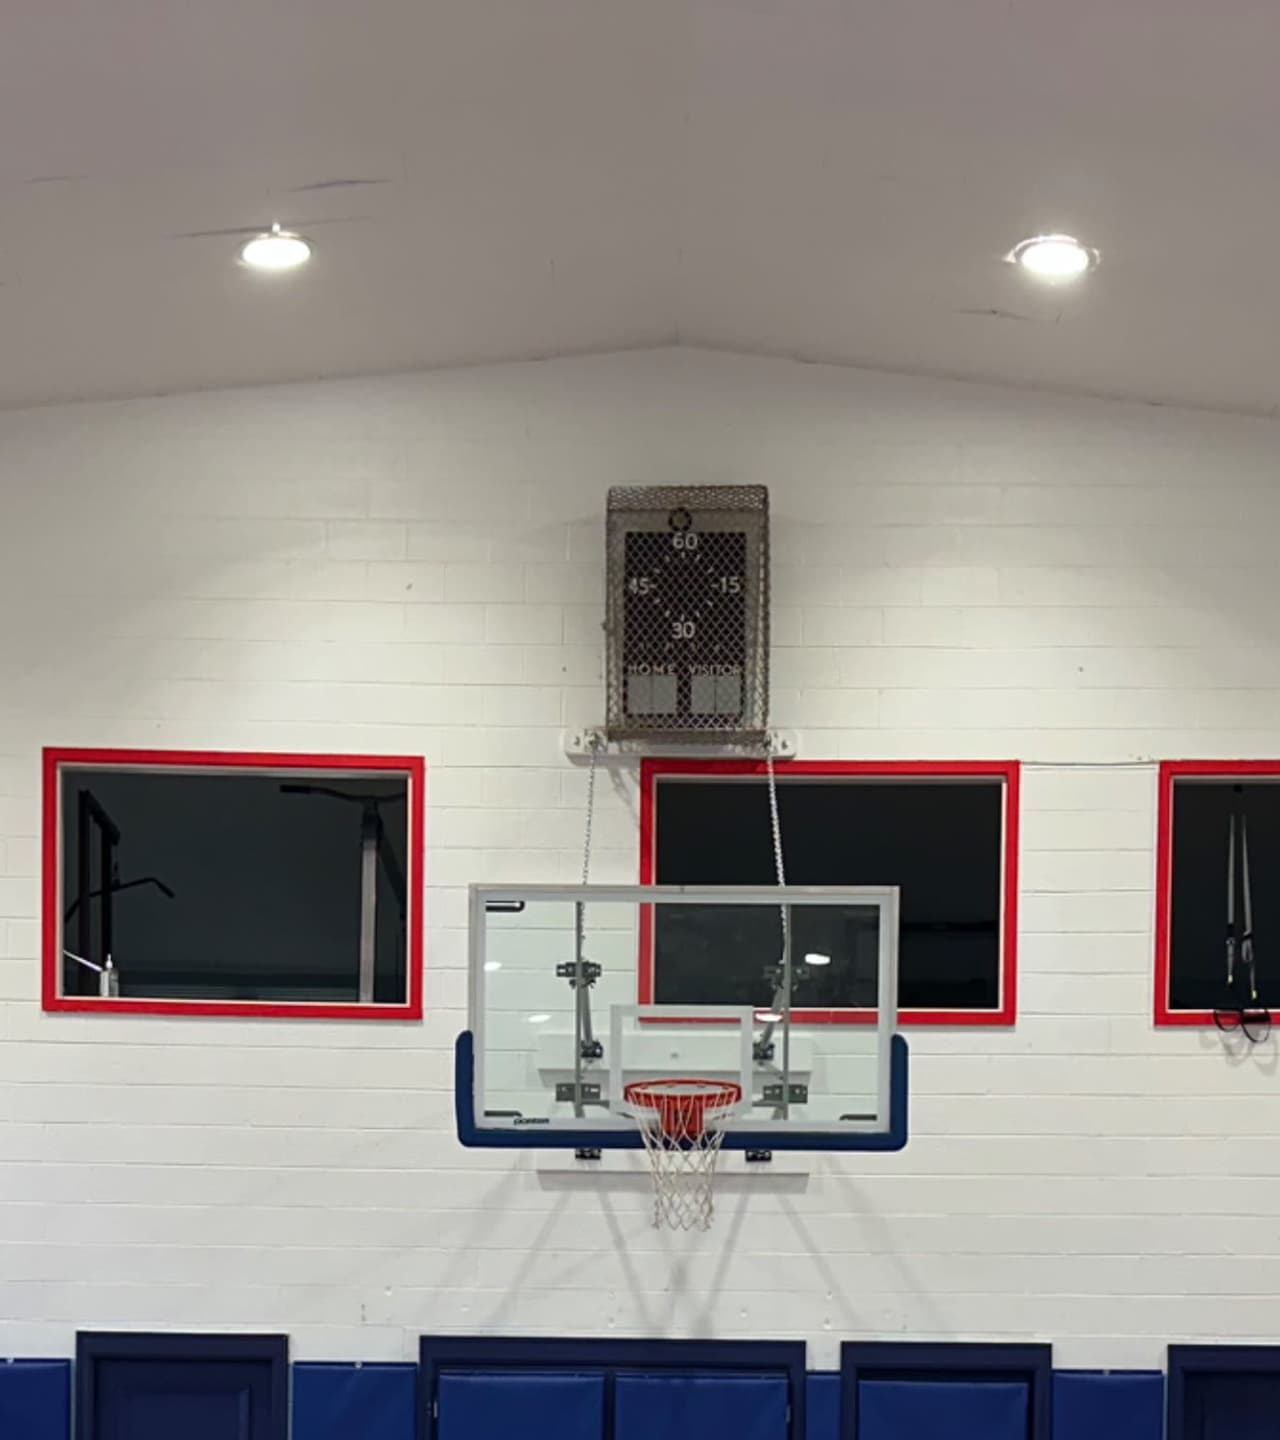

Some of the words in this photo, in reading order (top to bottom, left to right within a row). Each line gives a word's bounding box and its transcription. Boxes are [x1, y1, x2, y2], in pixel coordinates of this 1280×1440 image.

[673, 532, 698, 550] 60
[629, 578, 649, 595] 45
[721, 576, 740, 593] 15
[672, 621, 695, 639] 30
[628, 663, 675, 676] HOME
[688, 664, 740, 677] VISITOR
